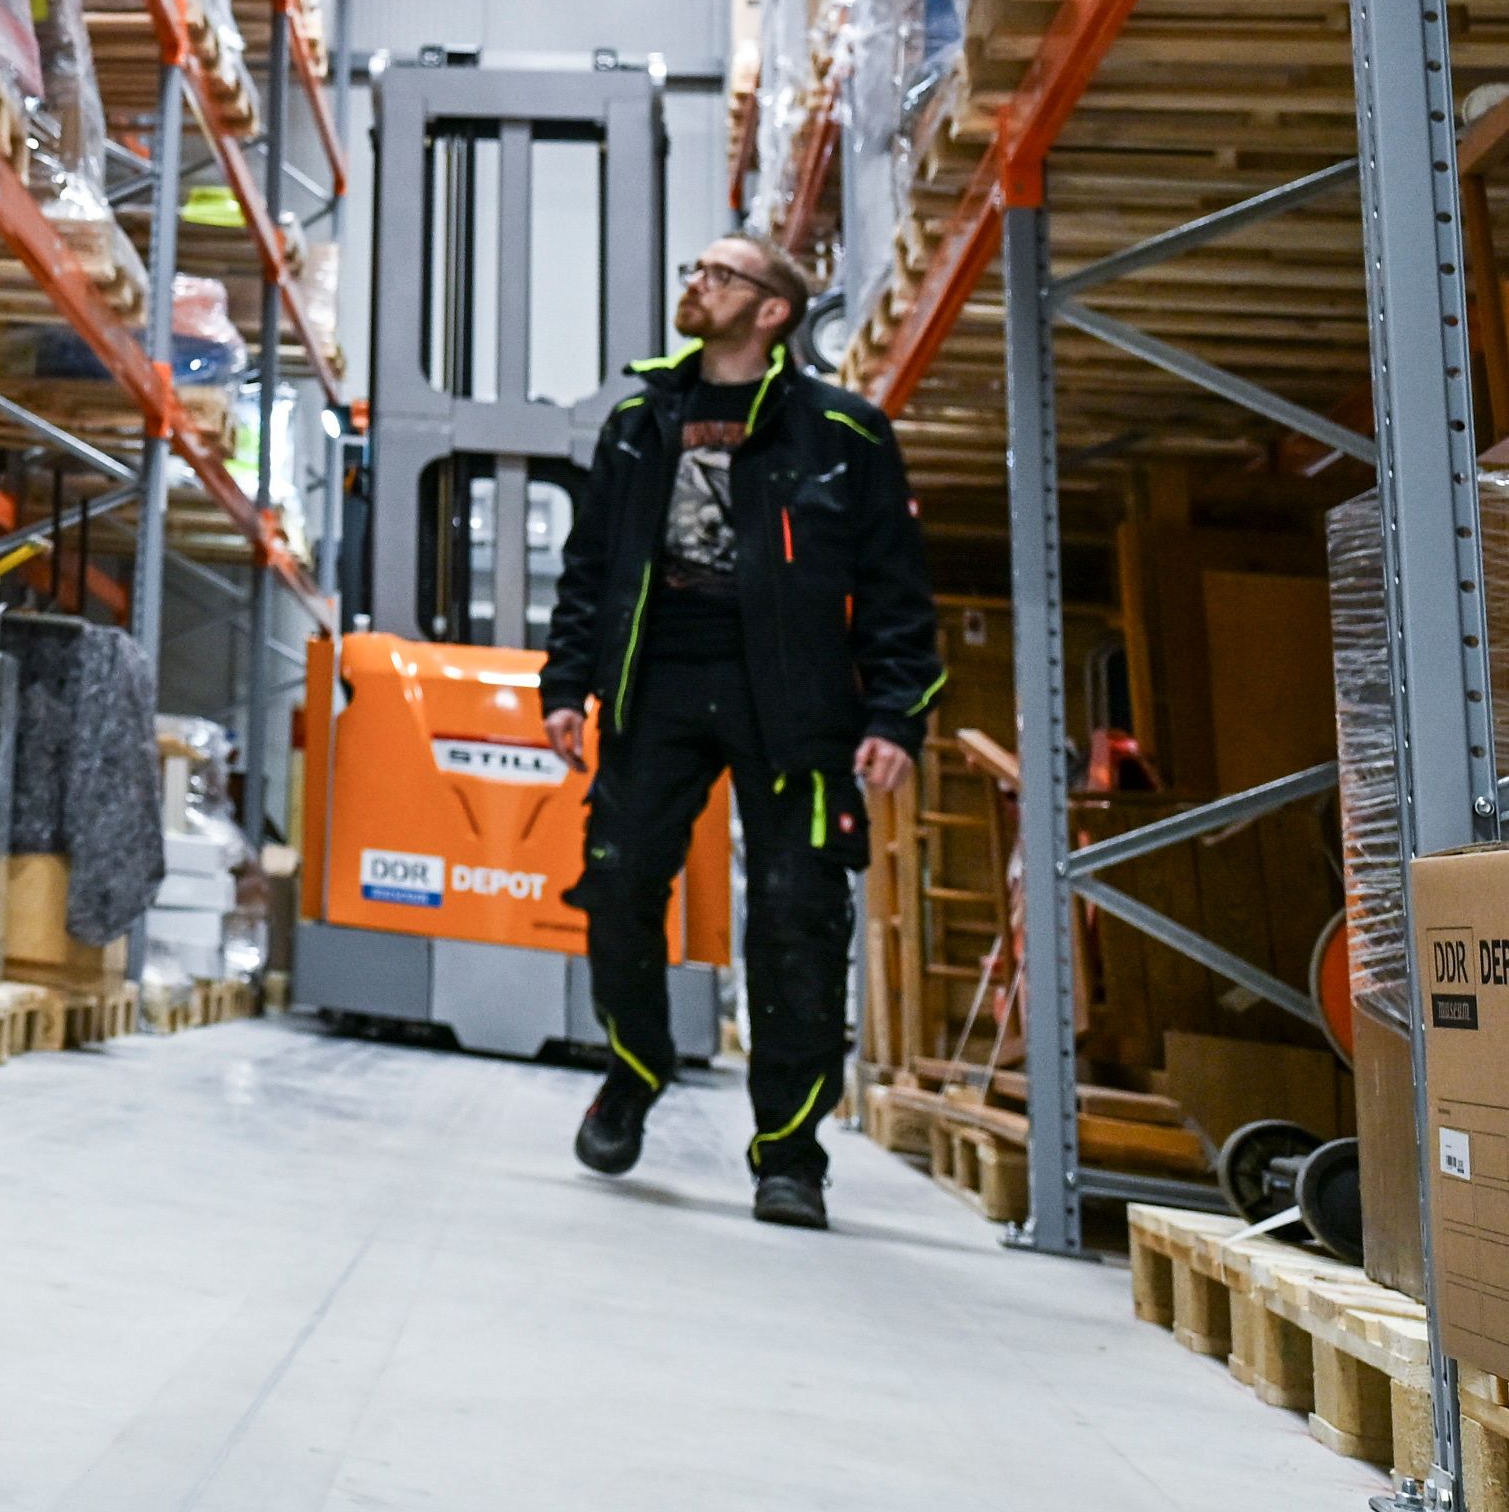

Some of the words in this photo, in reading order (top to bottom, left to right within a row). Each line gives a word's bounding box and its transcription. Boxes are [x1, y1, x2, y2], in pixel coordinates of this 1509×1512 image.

[447, 748, 555, 775] STILL
[370, 856, 430, 884] DDR
[451, 863, 548, 902] DEPOT
[1433, 940, 1469, 984] DDR
